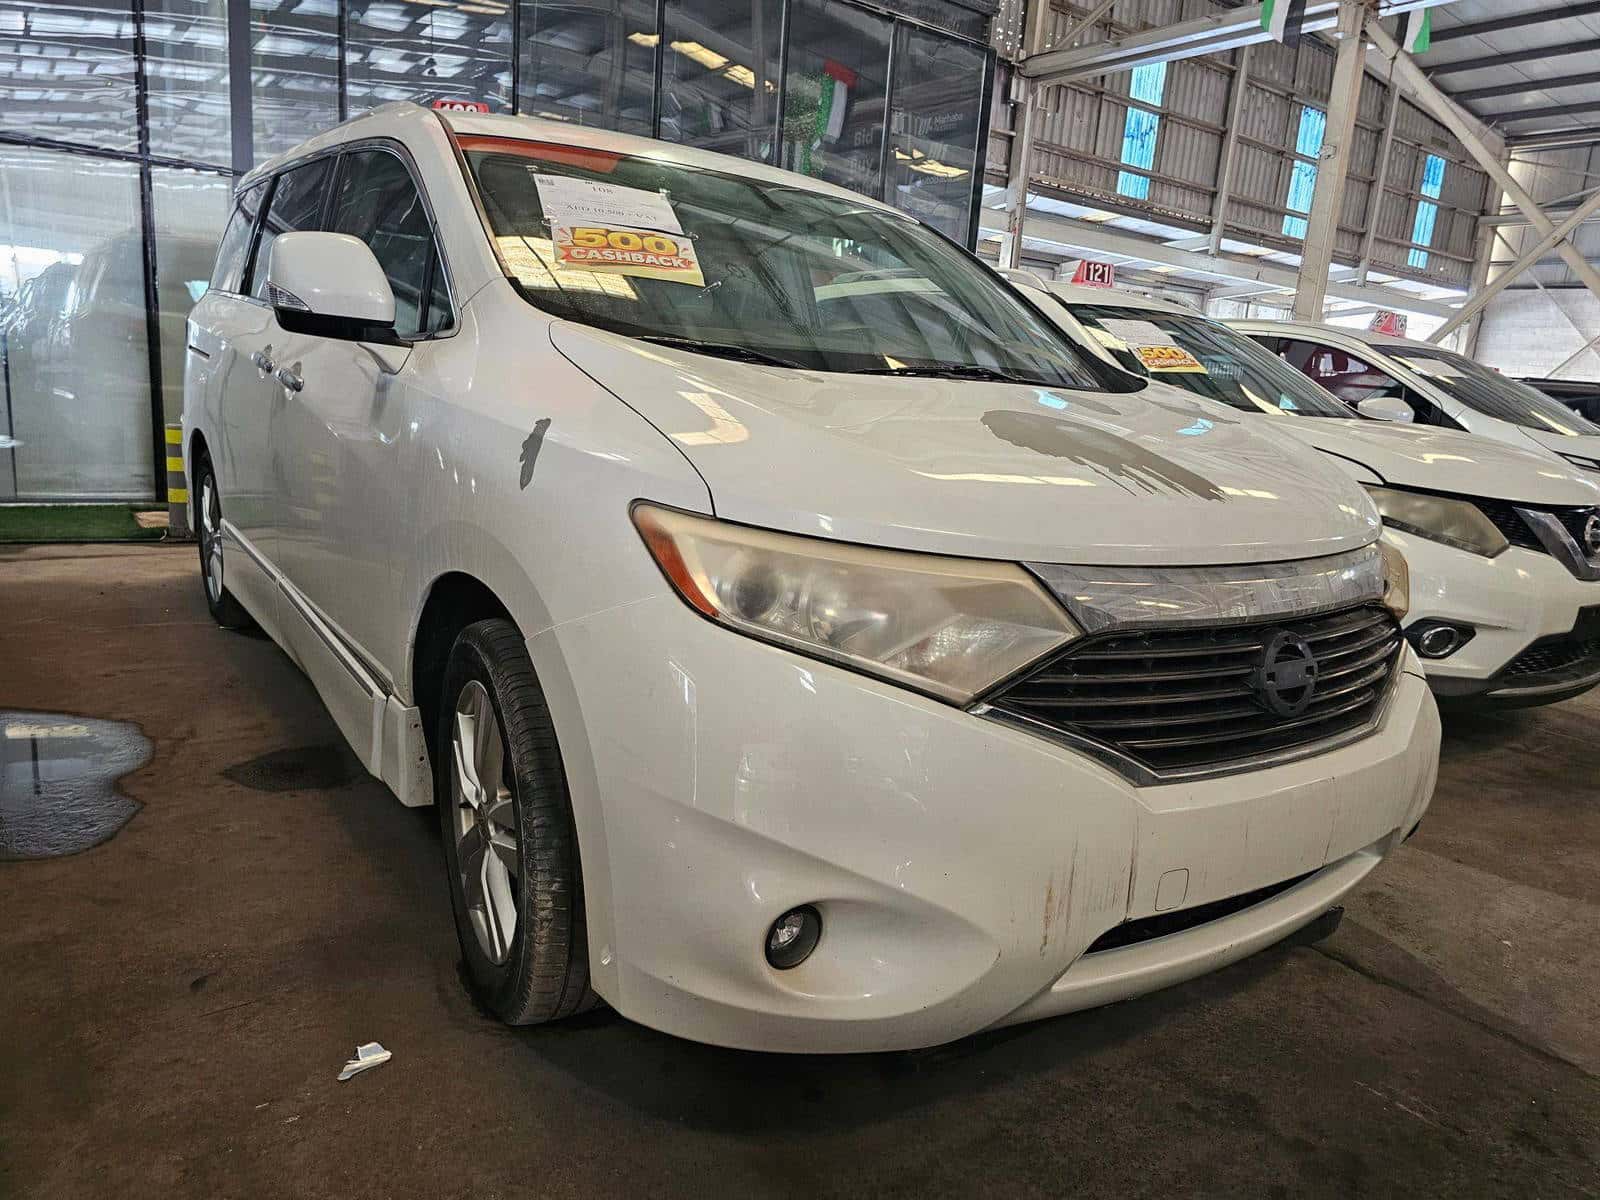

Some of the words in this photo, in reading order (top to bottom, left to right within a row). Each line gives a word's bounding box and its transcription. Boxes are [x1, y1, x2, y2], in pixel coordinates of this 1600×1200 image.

[573, 228, 678, 256] 500
[571, 248, 687, 268] CASHBACK
[1088, 263, 1109, 284] 121
[1139, 346, 1186, 360] 500
